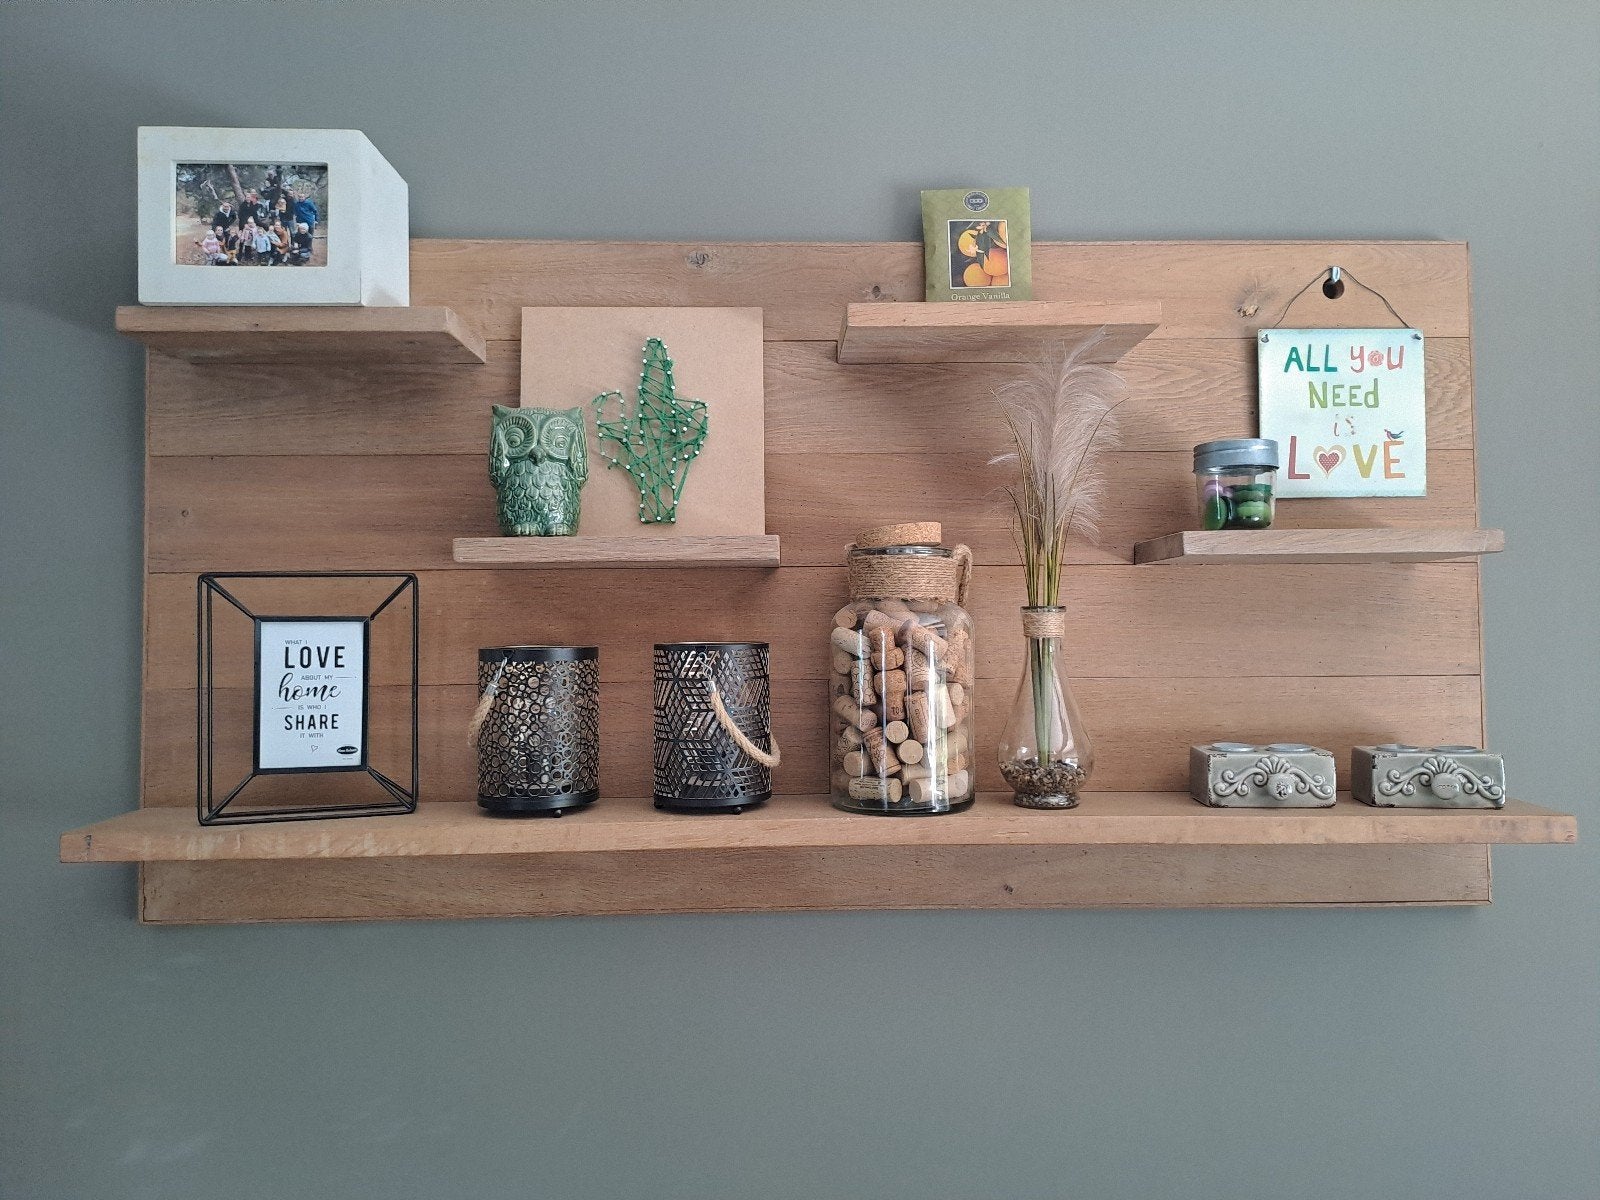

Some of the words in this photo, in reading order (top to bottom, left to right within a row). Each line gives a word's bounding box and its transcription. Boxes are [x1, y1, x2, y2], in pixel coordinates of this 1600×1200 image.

[951, 293, 980, 301] Orange
[981, 292, 1010, 300] Vanilla
[1284, 344, 1338, 373] ALL
[284, 645, 345, 669] LOVE
[278, 672, 342, 702] home
[284, 713, 339, 730] SHARE
